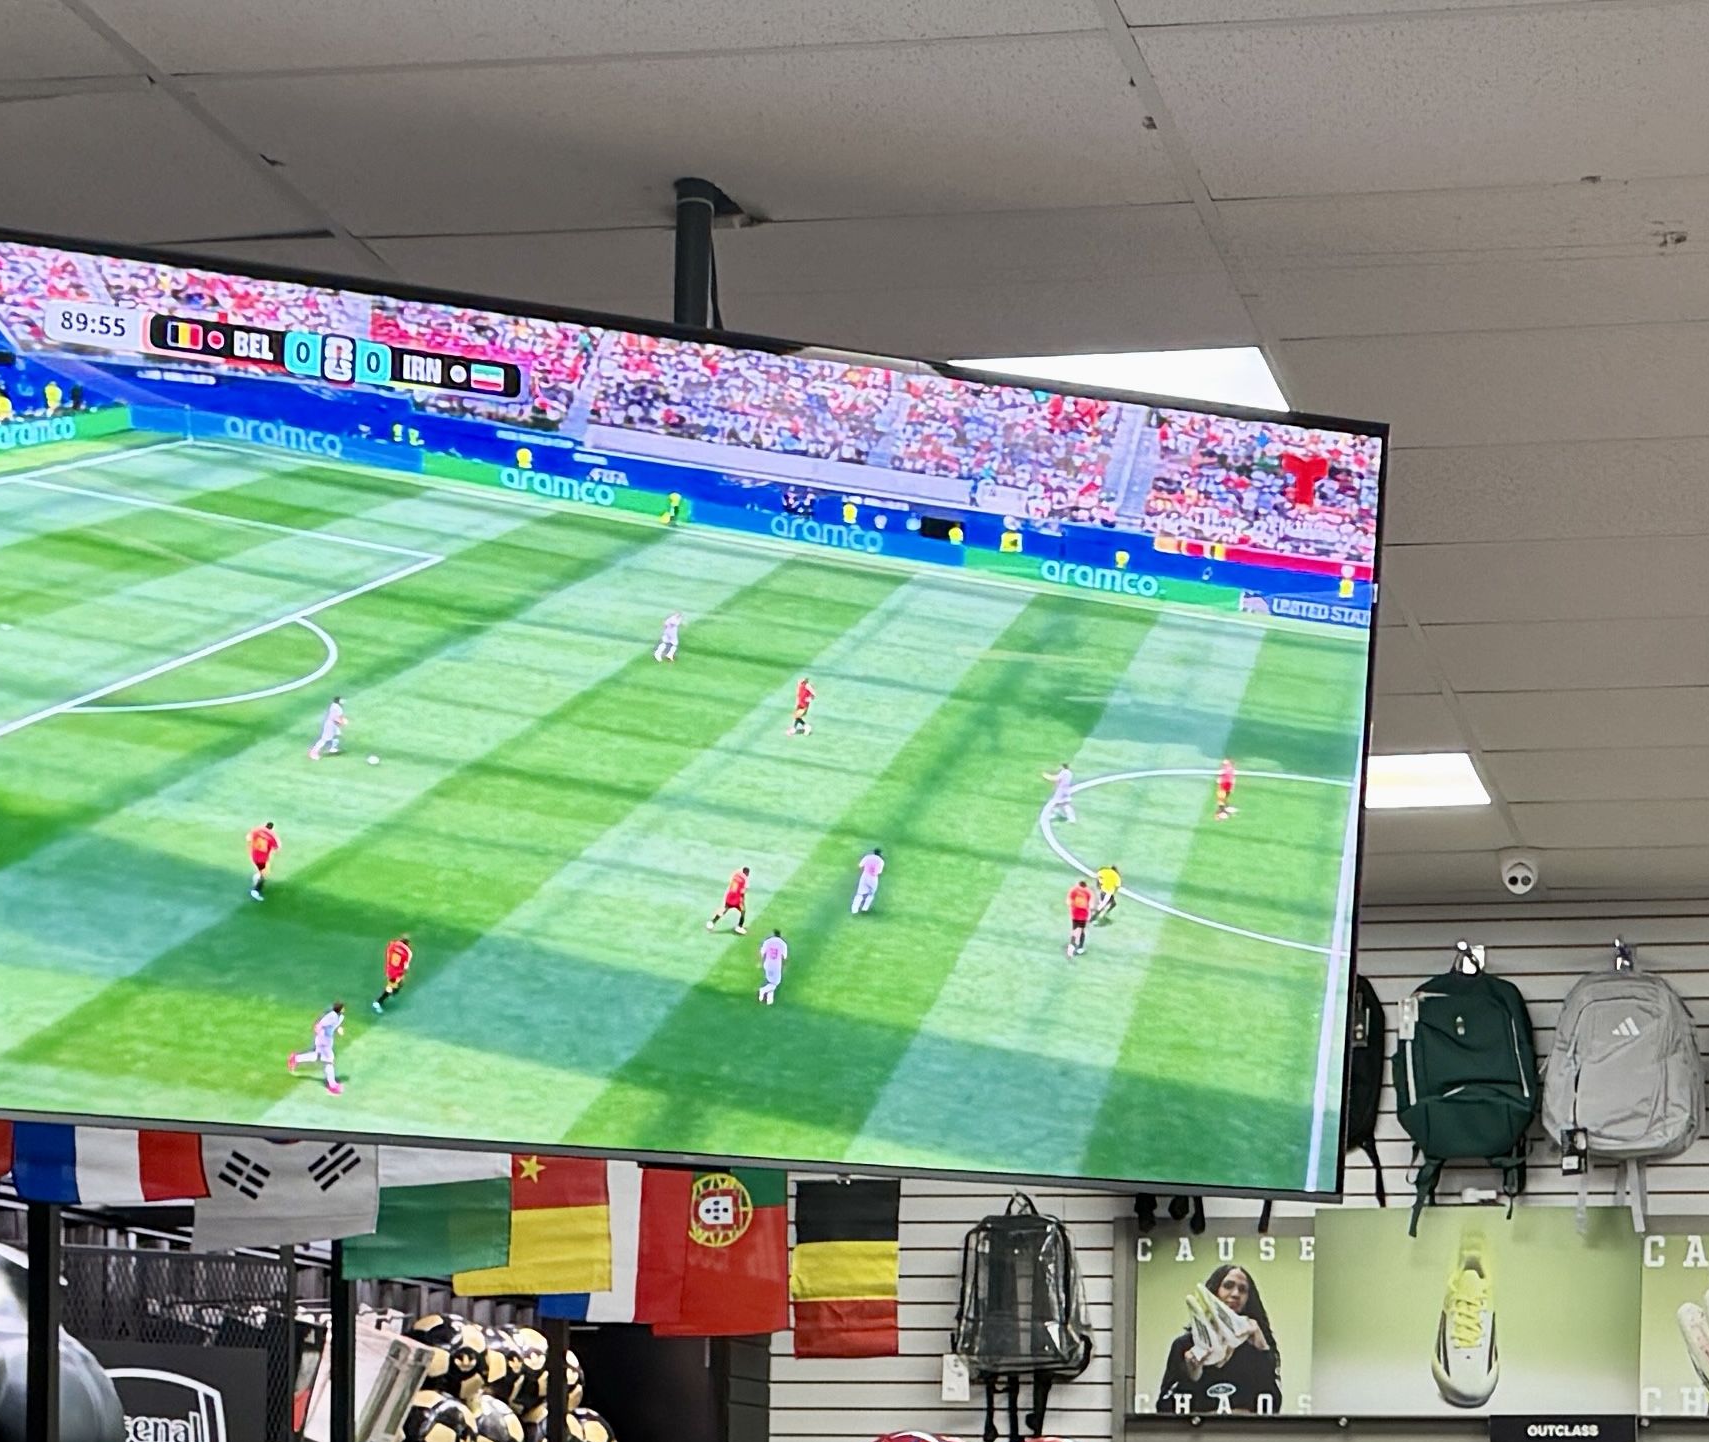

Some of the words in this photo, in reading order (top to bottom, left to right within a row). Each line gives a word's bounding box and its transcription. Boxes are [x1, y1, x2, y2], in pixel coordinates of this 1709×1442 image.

[60, 310, 126, 337] 89:55
[232, 330, 274, 361] BEL
[295, 341, 311, 364] 0
[366, 350, 381, 374] 0
[401, 353, 442, 384] IRN
[223, 415, 343, 457] aramco
[500, 467, 615, 506] aramco
[770, 513, 884, 554] aramco
[1041, 558, 1159, 597] aramco
[1136, 1236, 1316, 1262] CAUSE
[1134, 1393, 1313, 1415] CHAOS
[1526, 1423, 1599, 1437] OUTCLASS
